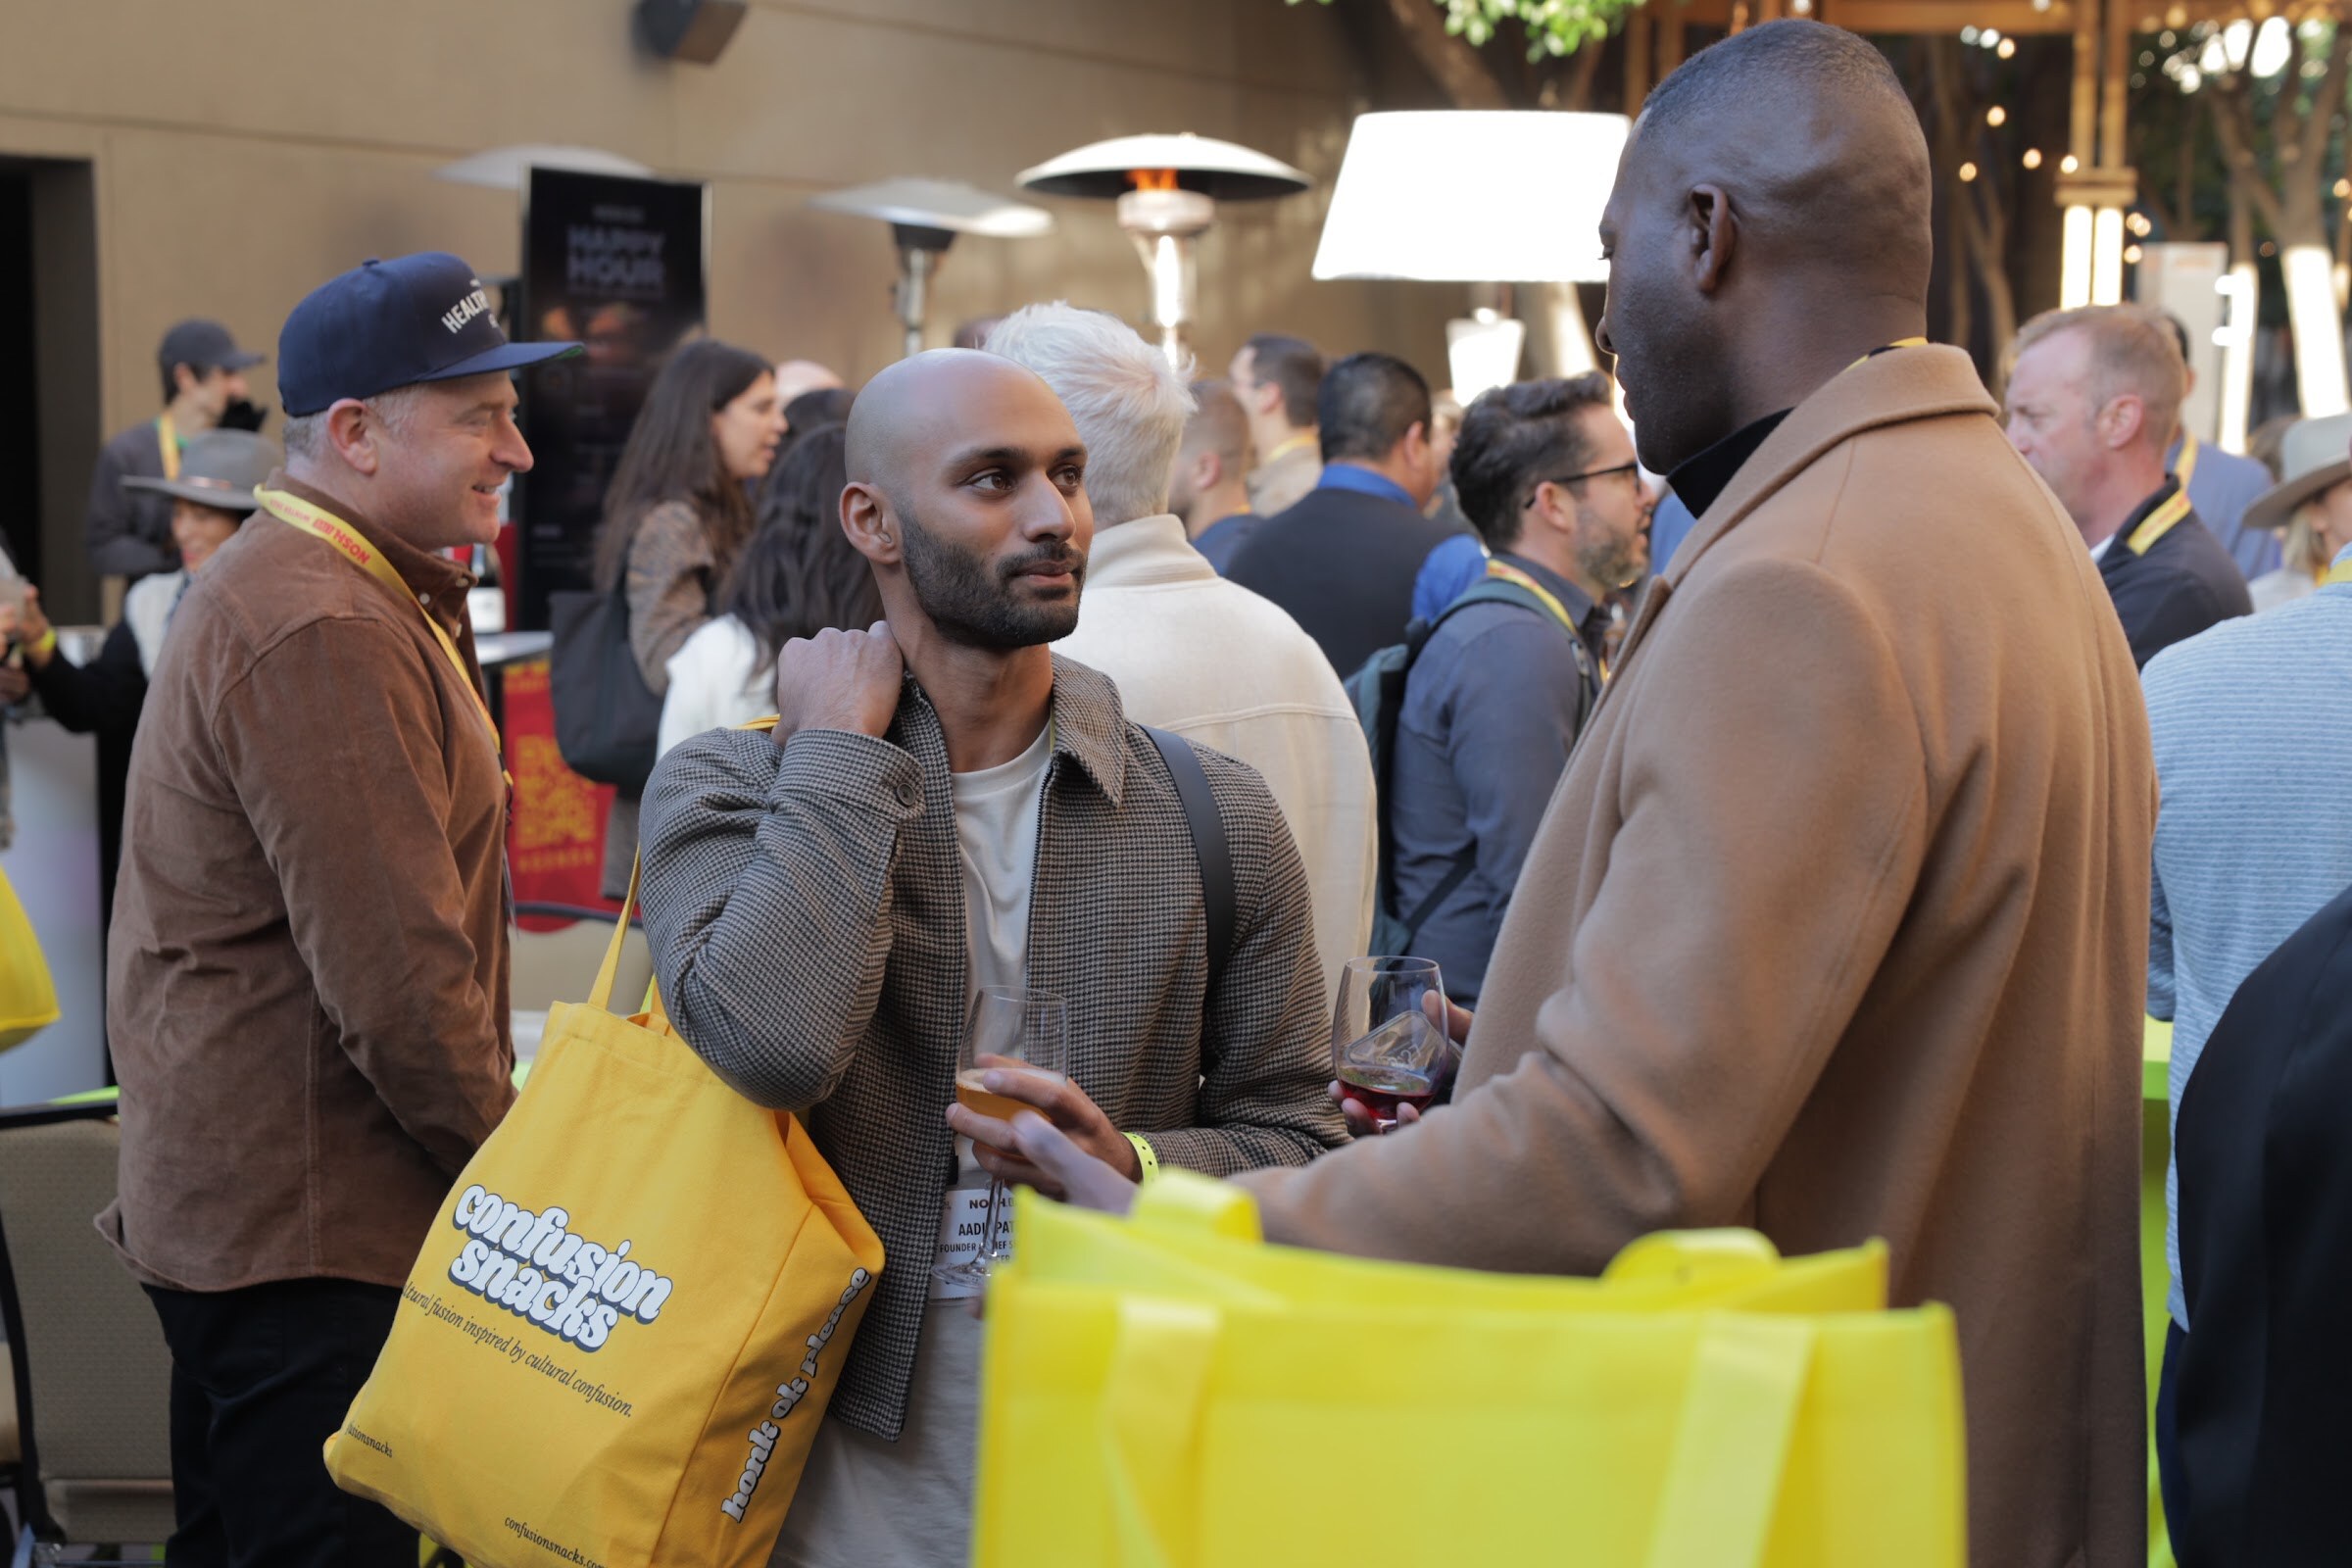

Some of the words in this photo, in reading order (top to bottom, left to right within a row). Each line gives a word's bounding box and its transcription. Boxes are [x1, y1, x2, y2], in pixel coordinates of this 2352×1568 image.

[453, 1184, 673, 1325] confusion
[940, 1243, 977, 1253] FOUNDER
[969, 1198, 1006, 1209] NOH
[448, 1239, 618, 1353] snacks
[425, 1298, 465, 1328] fusion
[463, 1316, 514, 1352] inspired
[509, 1340, 526, 1363] by
[524, 1354, 577, 1386] cultural
[571, 1379, 632, 1417] confusion.
[721, 1420, 781, 1524] honk
[771, 1377, 808, 1419] ok
[801, 1267, 870, 1377] please
